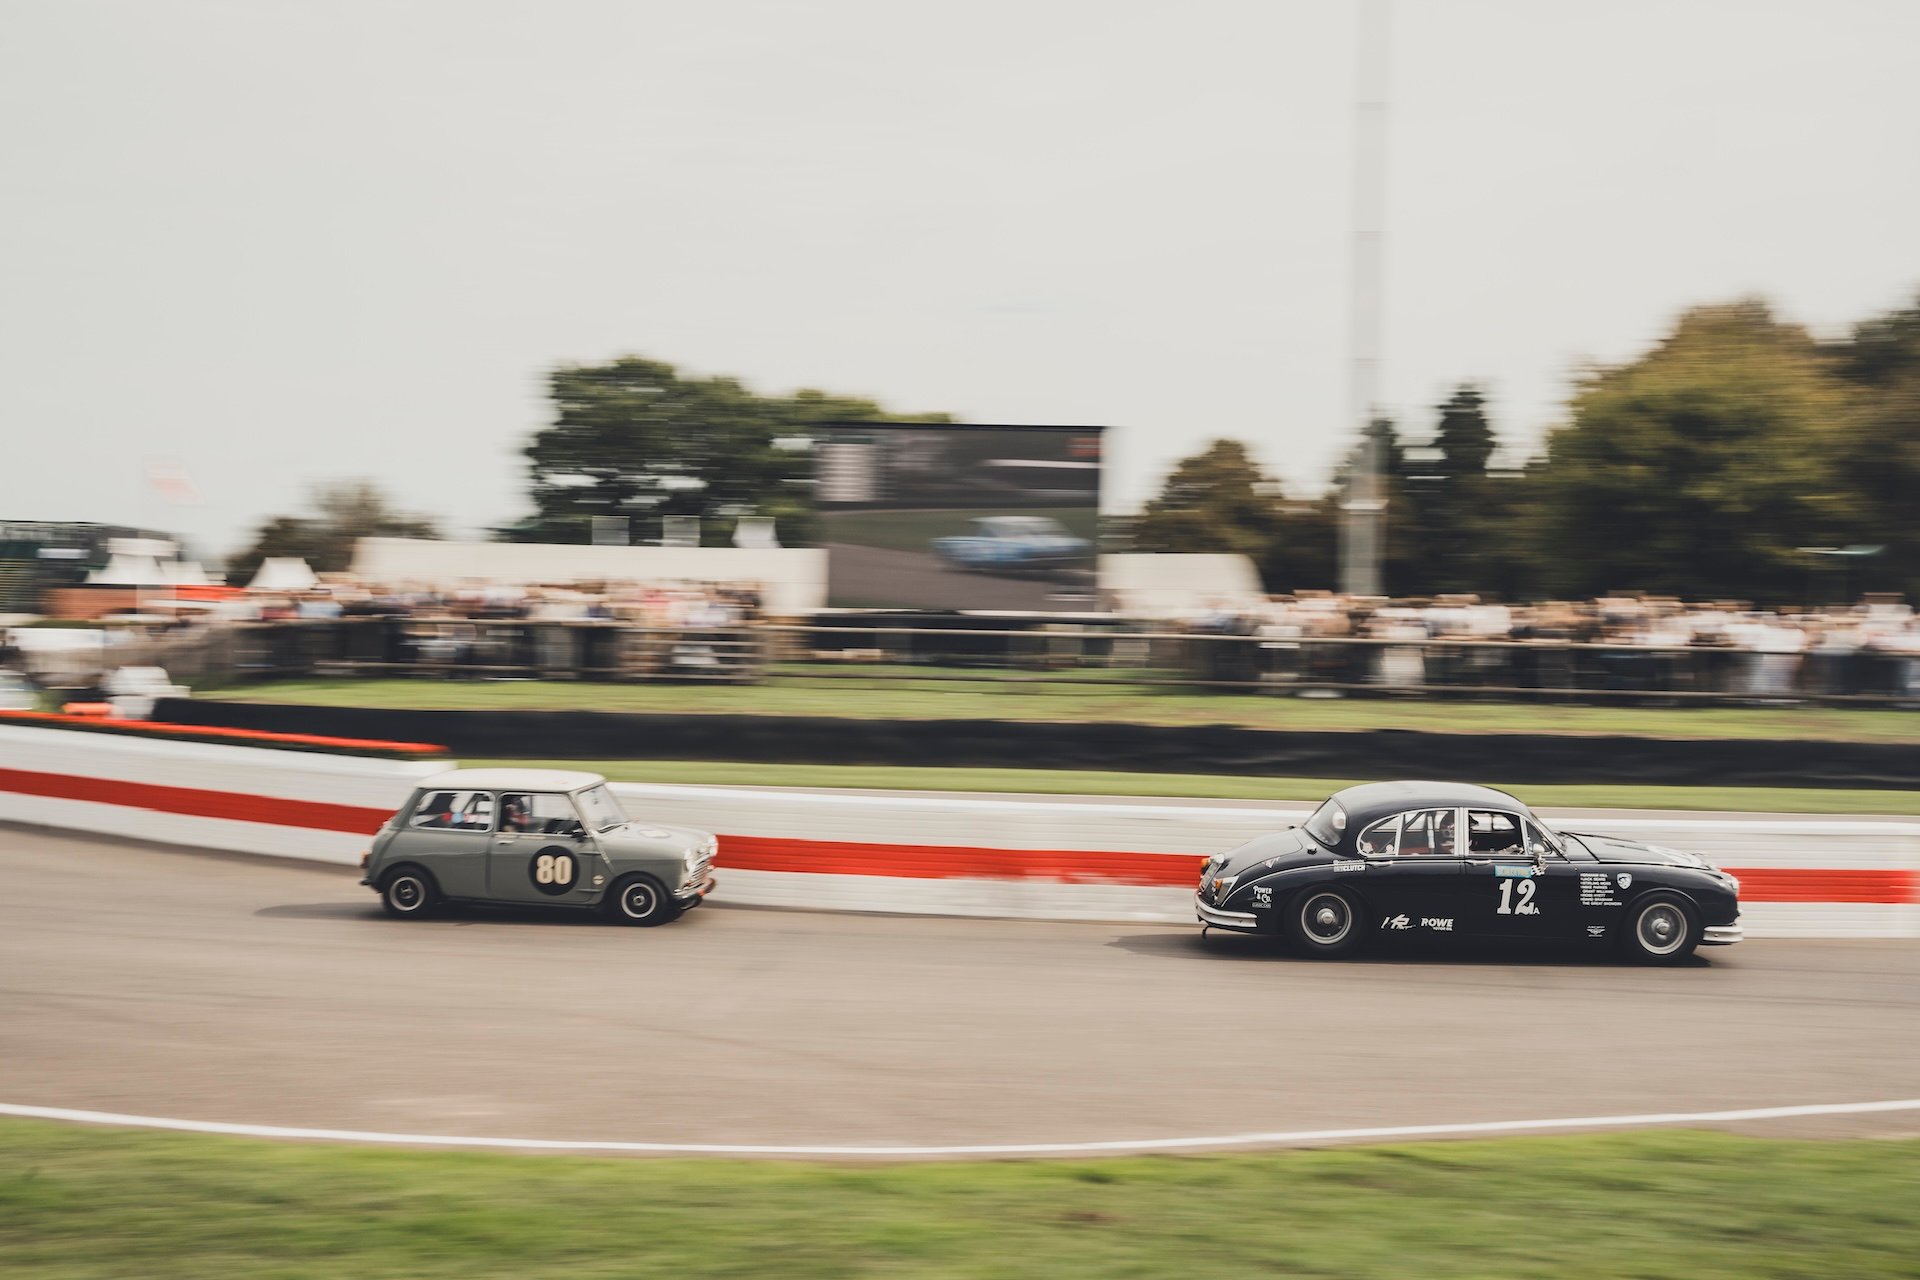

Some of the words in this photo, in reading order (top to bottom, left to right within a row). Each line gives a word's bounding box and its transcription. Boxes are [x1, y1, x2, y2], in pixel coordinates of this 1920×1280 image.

[536, 855, 572, 885] 80
[1253, 885, 1272, 894] POWER
[1421, 917, 1454, 928] ROWE
